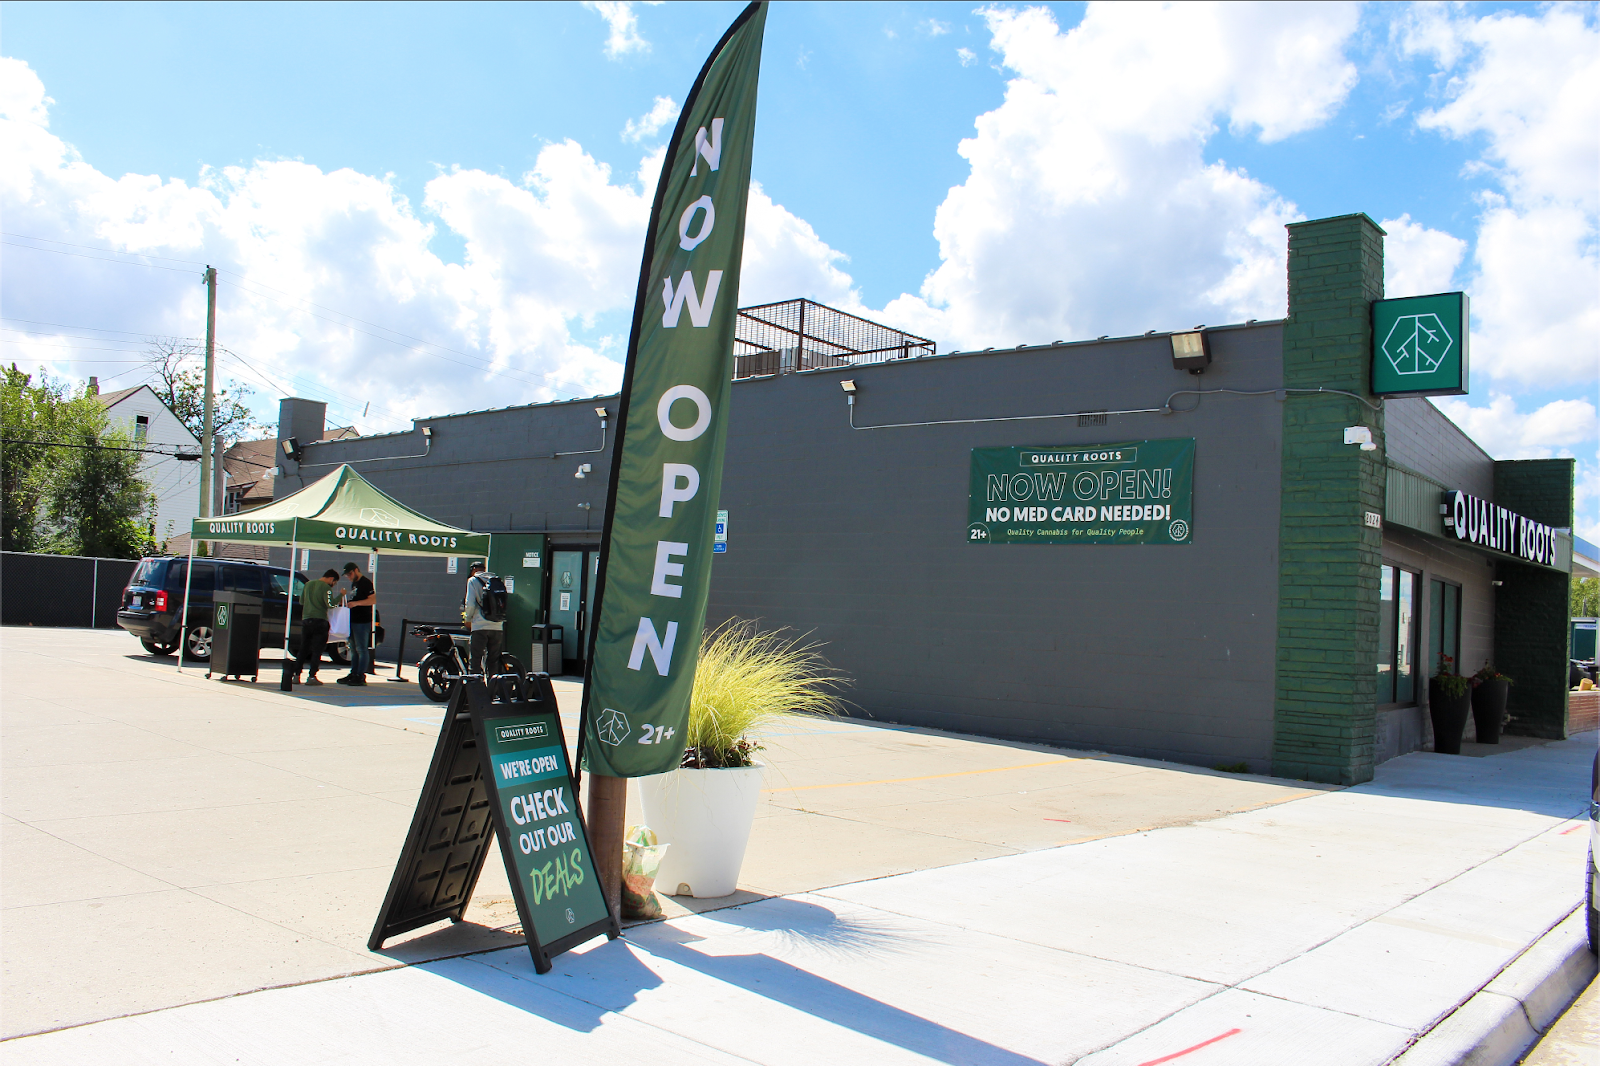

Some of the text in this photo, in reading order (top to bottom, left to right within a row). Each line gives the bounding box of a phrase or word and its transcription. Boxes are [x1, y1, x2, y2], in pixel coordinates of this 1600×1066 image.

[627, 117, 724, 677] NOW OPEN
[1031, 451, 1122, 464] QUALITY ROOTS
[987, 468, 1172, 502] NOW OPEN!
[985, 504, 1171, 523] NO MED CARD NEEDED!
[209, 522, 275, 534] QUALITY ROOTS
[335, 526, 458, 548] QUALITY ROOTS
[970, 529, 987, 540] 21+
[1007, 529, 1034, 537] Quality
[1071, 528, 1084, 536] for
[1086, 528, 1116, 537] Quality
[1118, 528, 1144, 537] People
[1454, 490, 1557, 566] QUALITY ROOTS
[500, 725, 544, 739] QUALITY ROOTS
[638, 723, 675, 746] 21+
[500, 754, 559, 780] WE'RE OPEN
[510, 786, 569, 826] CHECK
[519, 821, 576, 855] OUT OUR
[529, 847, 584, 905] DEALS
